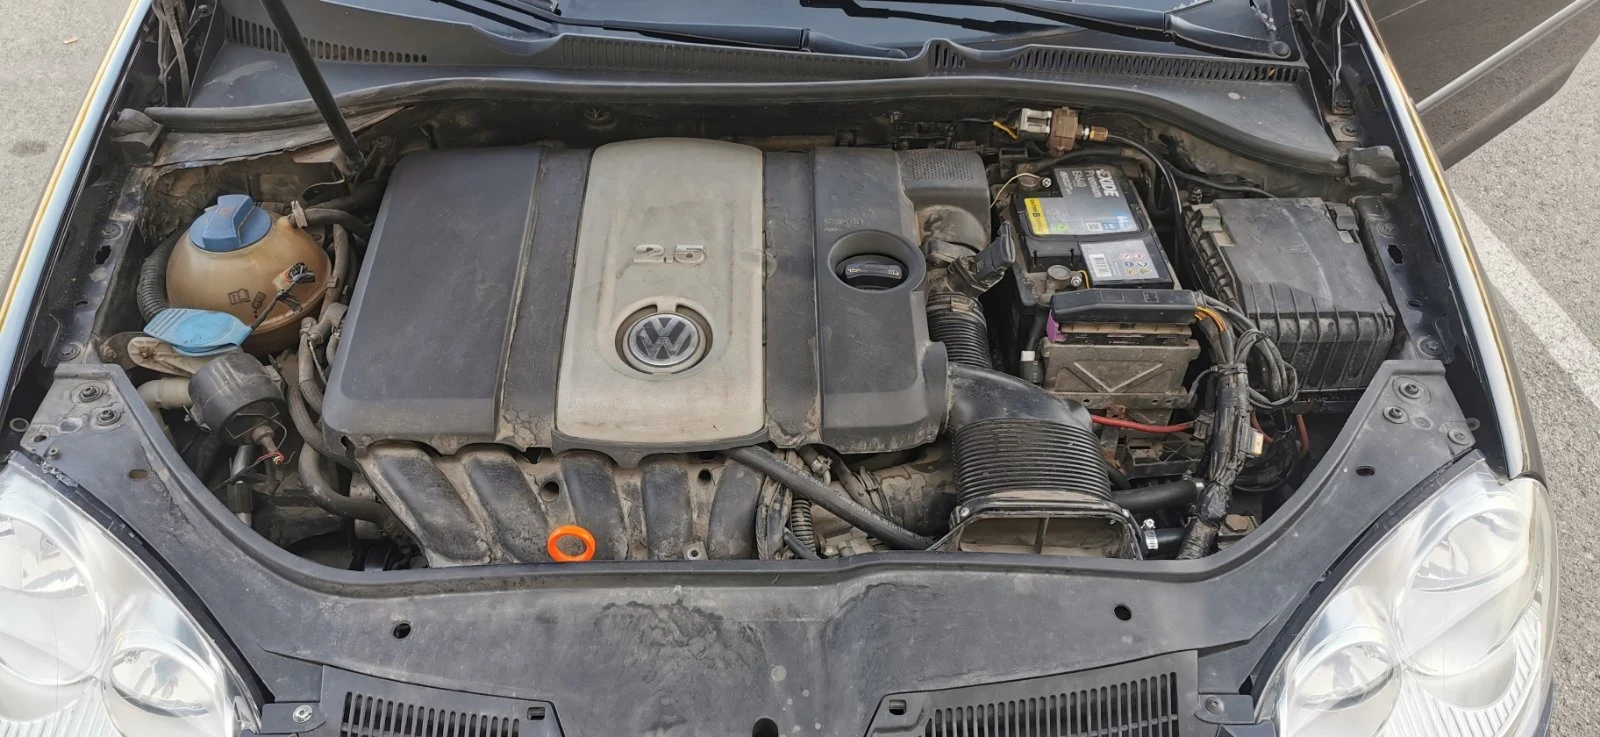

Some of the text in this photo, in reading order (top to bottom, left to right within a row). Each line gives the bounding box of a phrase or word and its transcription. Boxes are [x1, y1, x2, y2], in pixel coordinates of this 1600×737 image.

[1085, 170, 1102, 198] Premium
[1096, 168, 1120, 197] EXIDE
[634, 244, 707, 265] 2.5
